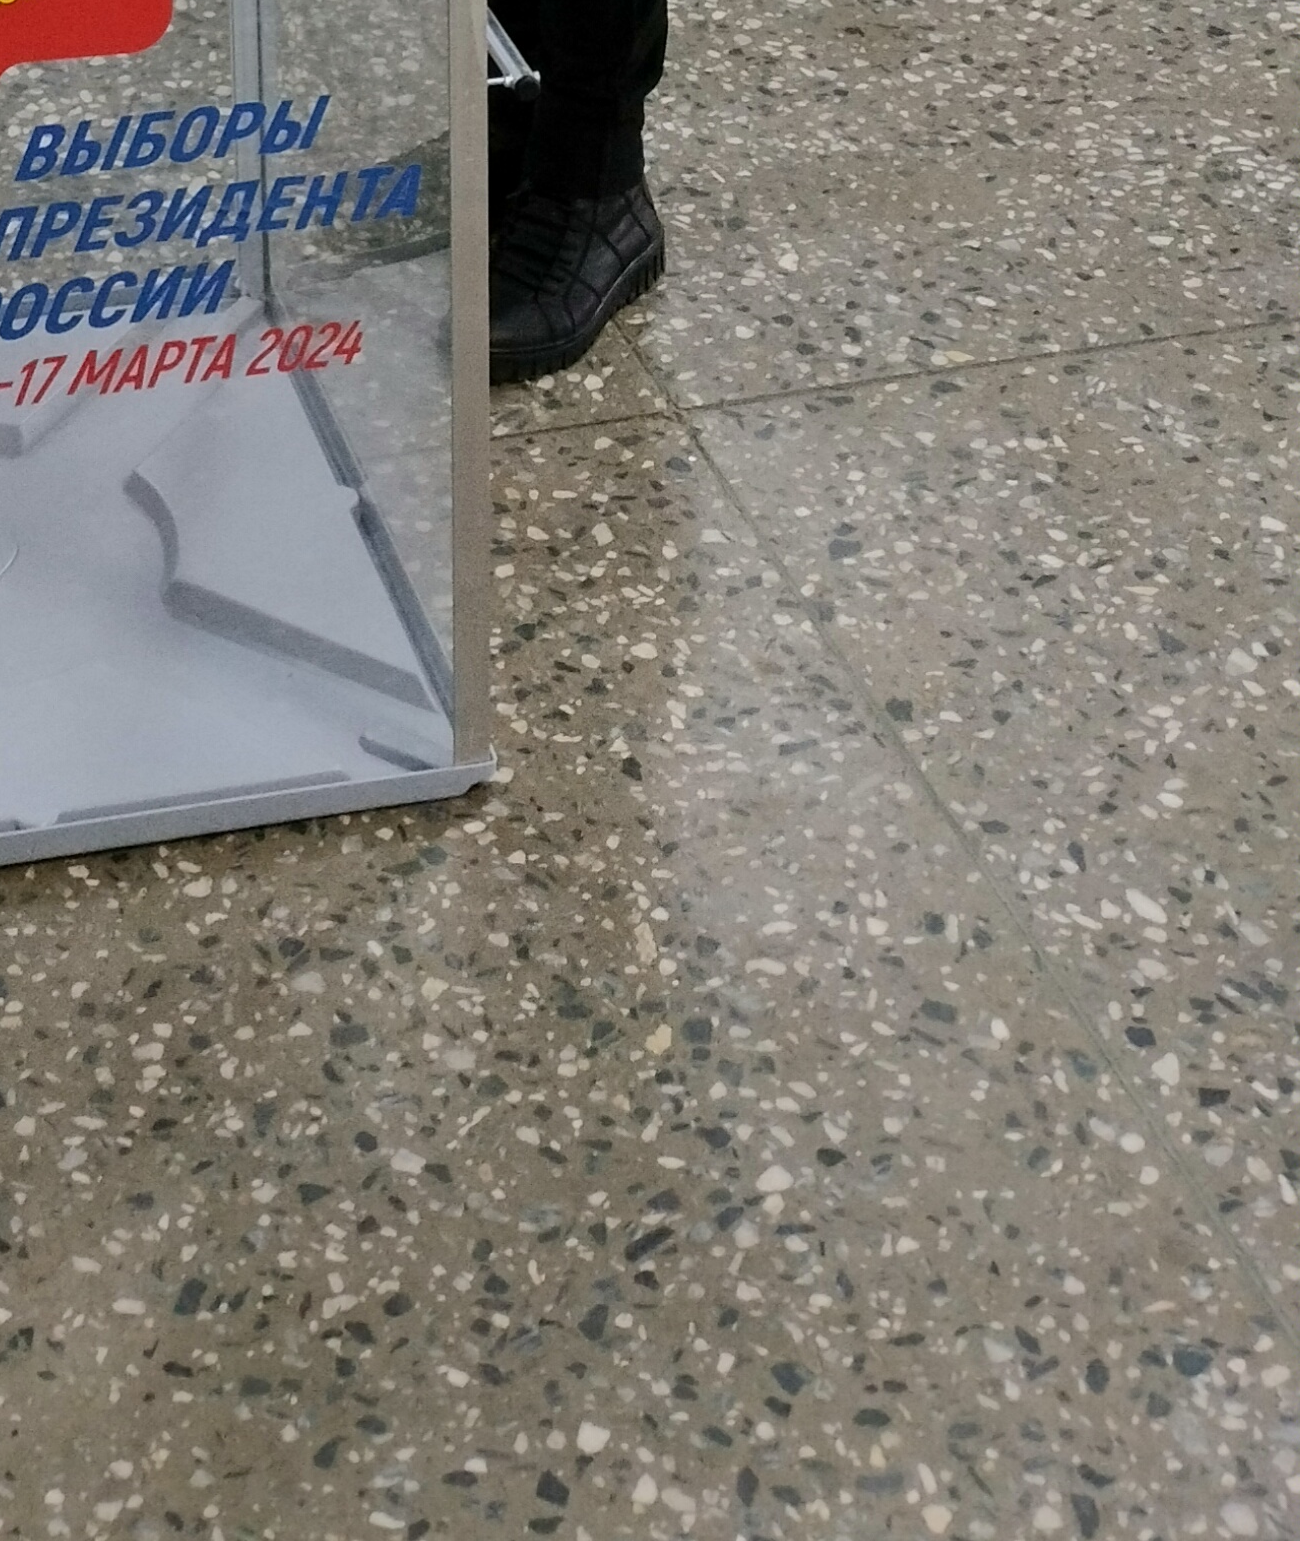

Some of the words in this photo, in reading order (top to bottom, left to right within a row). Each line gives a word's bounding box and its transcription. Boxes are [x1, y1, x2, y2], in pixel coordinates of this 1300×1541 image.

[15, 95, 331, 182] ВЫБОРЫ
[67, 334, 236, 395] МАРТА
[245, 319, 365, 377] 2024
